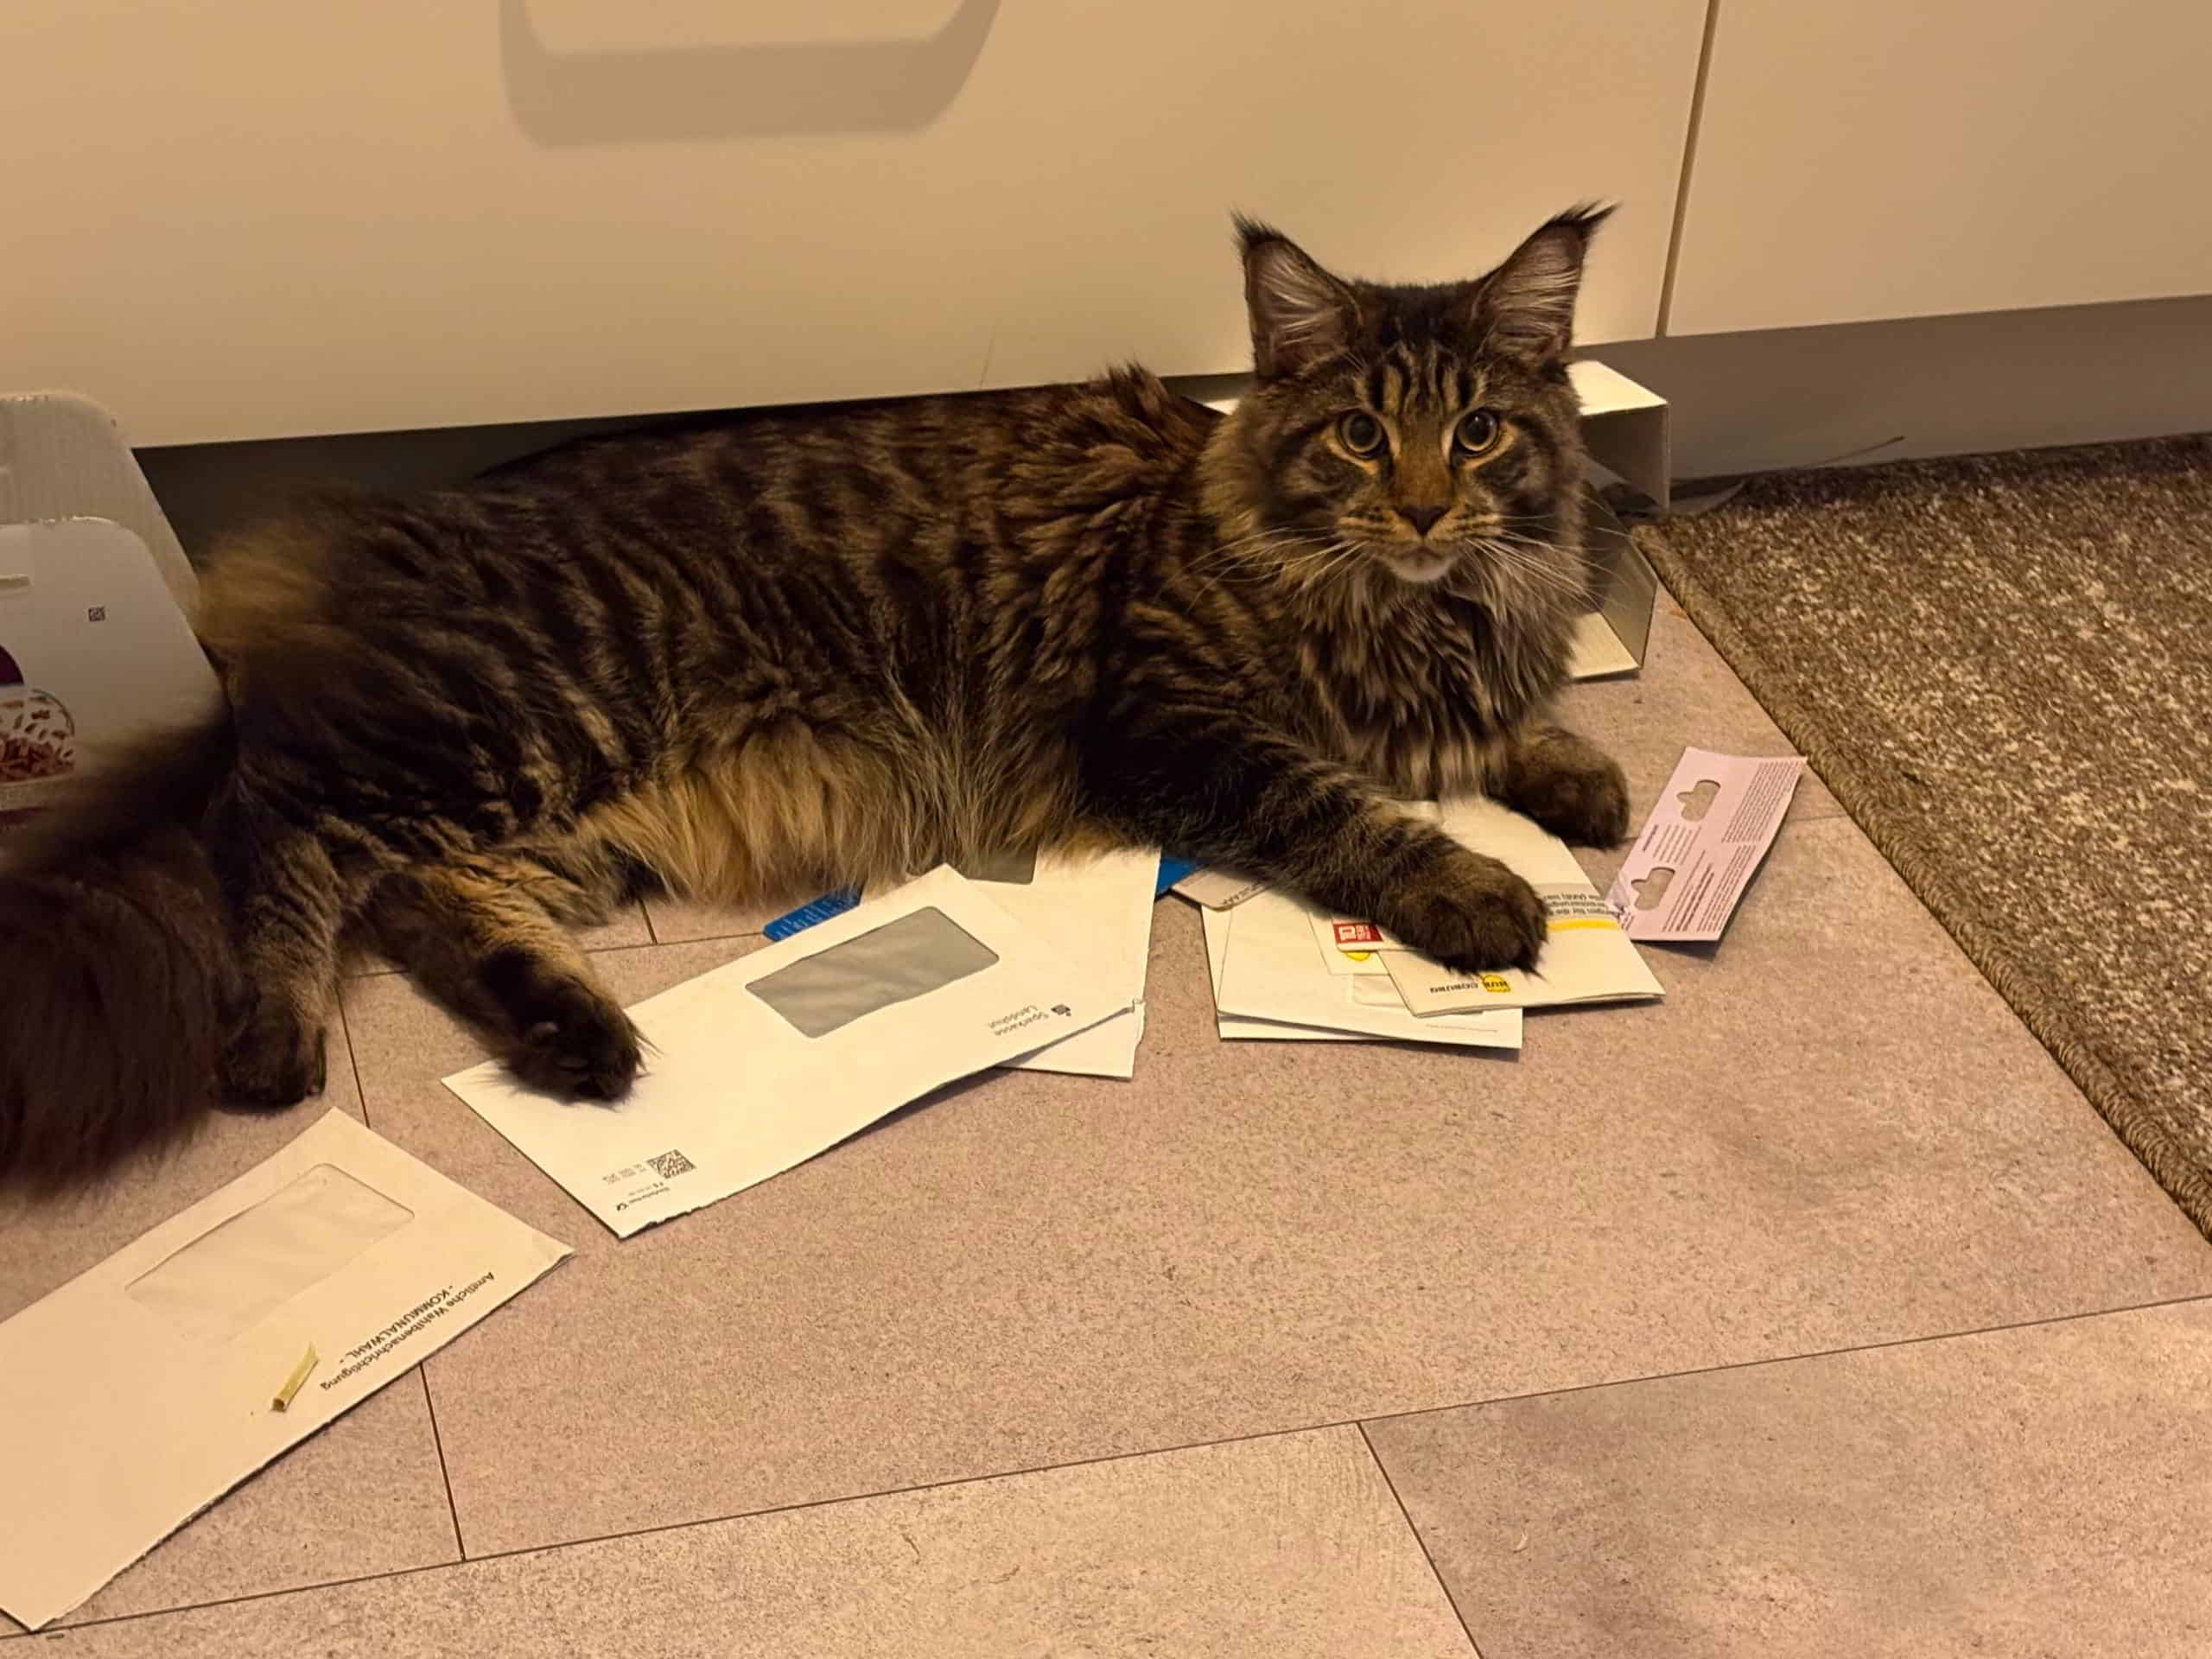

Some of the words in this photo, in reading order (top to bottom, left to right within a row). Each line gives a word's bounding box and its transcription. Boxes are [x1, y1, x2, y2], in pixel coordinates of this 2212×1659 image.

[345, 1287, 451, 1361] KOMMUNALWAHL
[445, 1271, 495, 1308] Amtliche
[319, 1306, 450, 1390] Wahlbenachrichtigung
